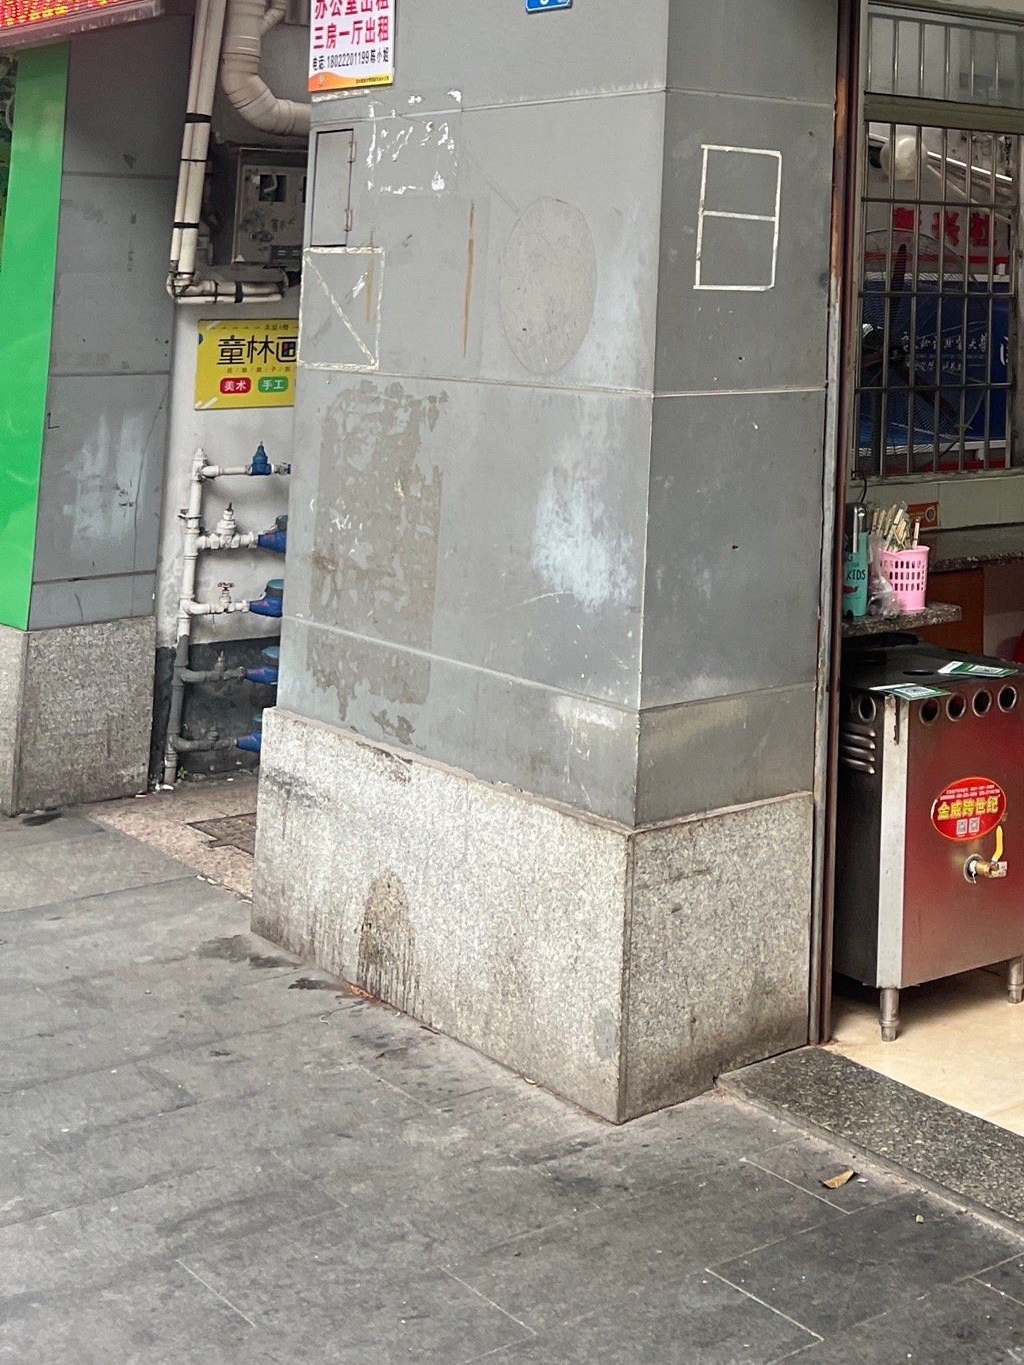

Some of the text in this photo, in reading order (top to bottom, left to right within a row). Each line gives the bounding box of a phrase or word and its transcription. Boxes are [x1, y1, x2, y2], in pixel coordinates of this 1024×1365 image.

[313, 16, 389, 49] 三房一厅出租
[217, 335, 298, 365] 童林画
[225, 379, 247, 392] 美术
[262, 379, 283, 390] 手工
[846, 569, 866, 581] KIDS
